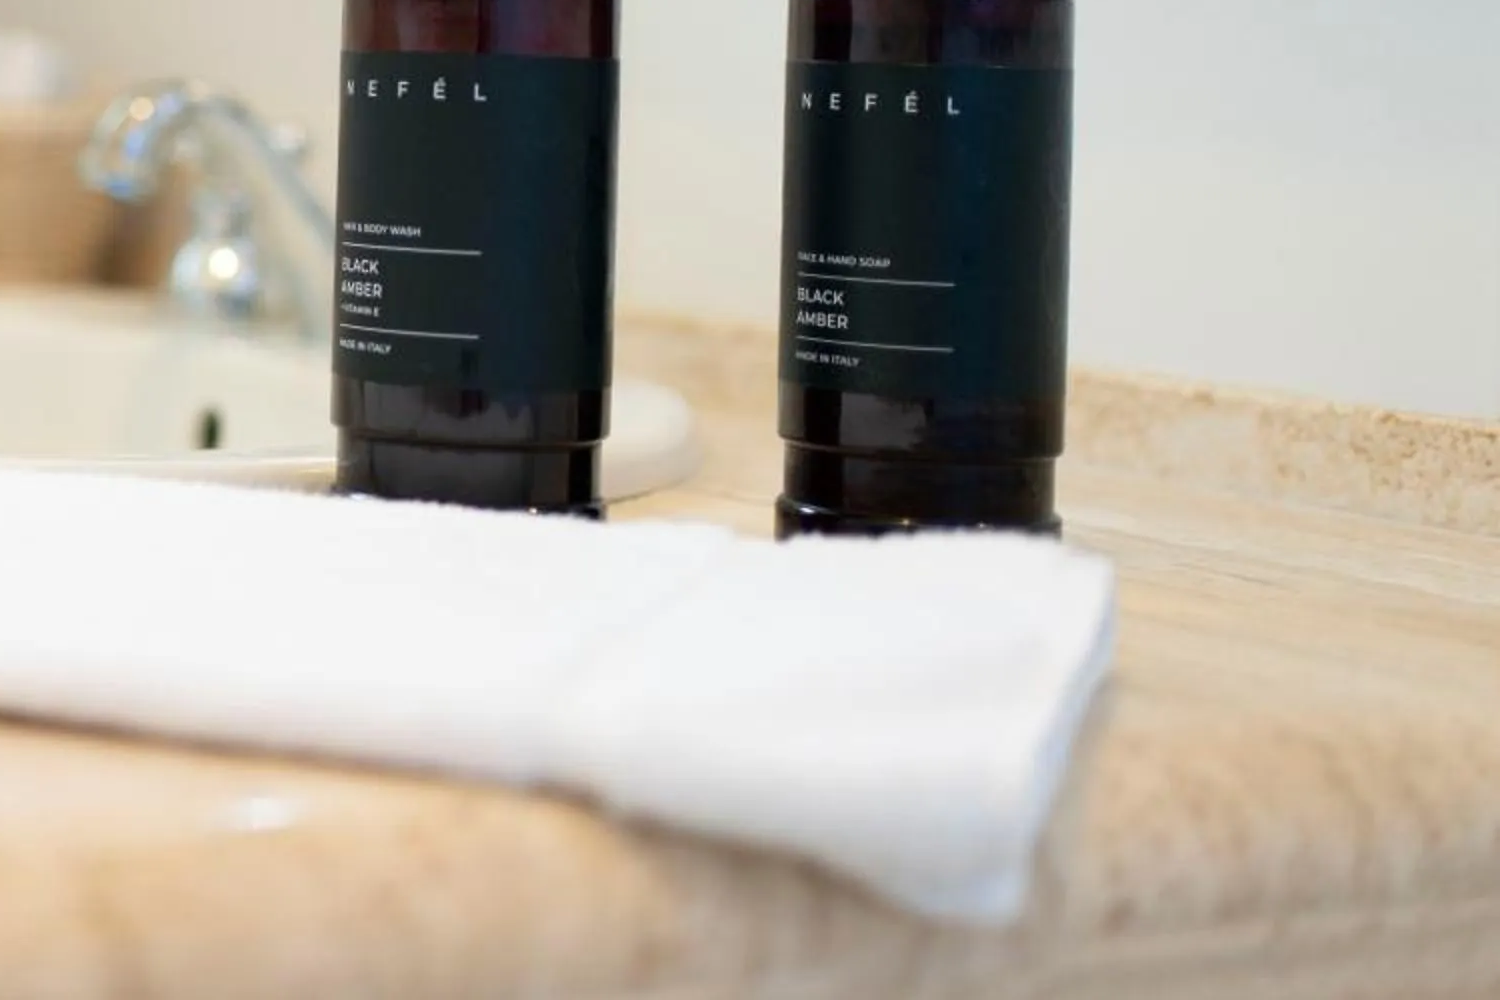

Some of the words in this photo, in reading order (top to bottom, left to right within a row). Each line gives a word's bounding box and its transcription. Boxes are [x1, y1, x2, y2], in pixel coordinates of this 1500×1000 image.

[346, 76, 488, 102] NEFÉL
[801, 90, 961, 115] NEFÉL
[363, 223, 388, 235] BODY
[389, 224, 422, 238] WASH
[341, 256, 380, 275] BLACK
[859, 256, 891, 267] SOAP
[341, 279, 383, 299] AMBER
[797, 286, 844, 306] BLACK
[796, 309, 850, 330] AMBER
[367, 341, 392, 355] ITALY
[831, 353, 861, 368] ITALY
